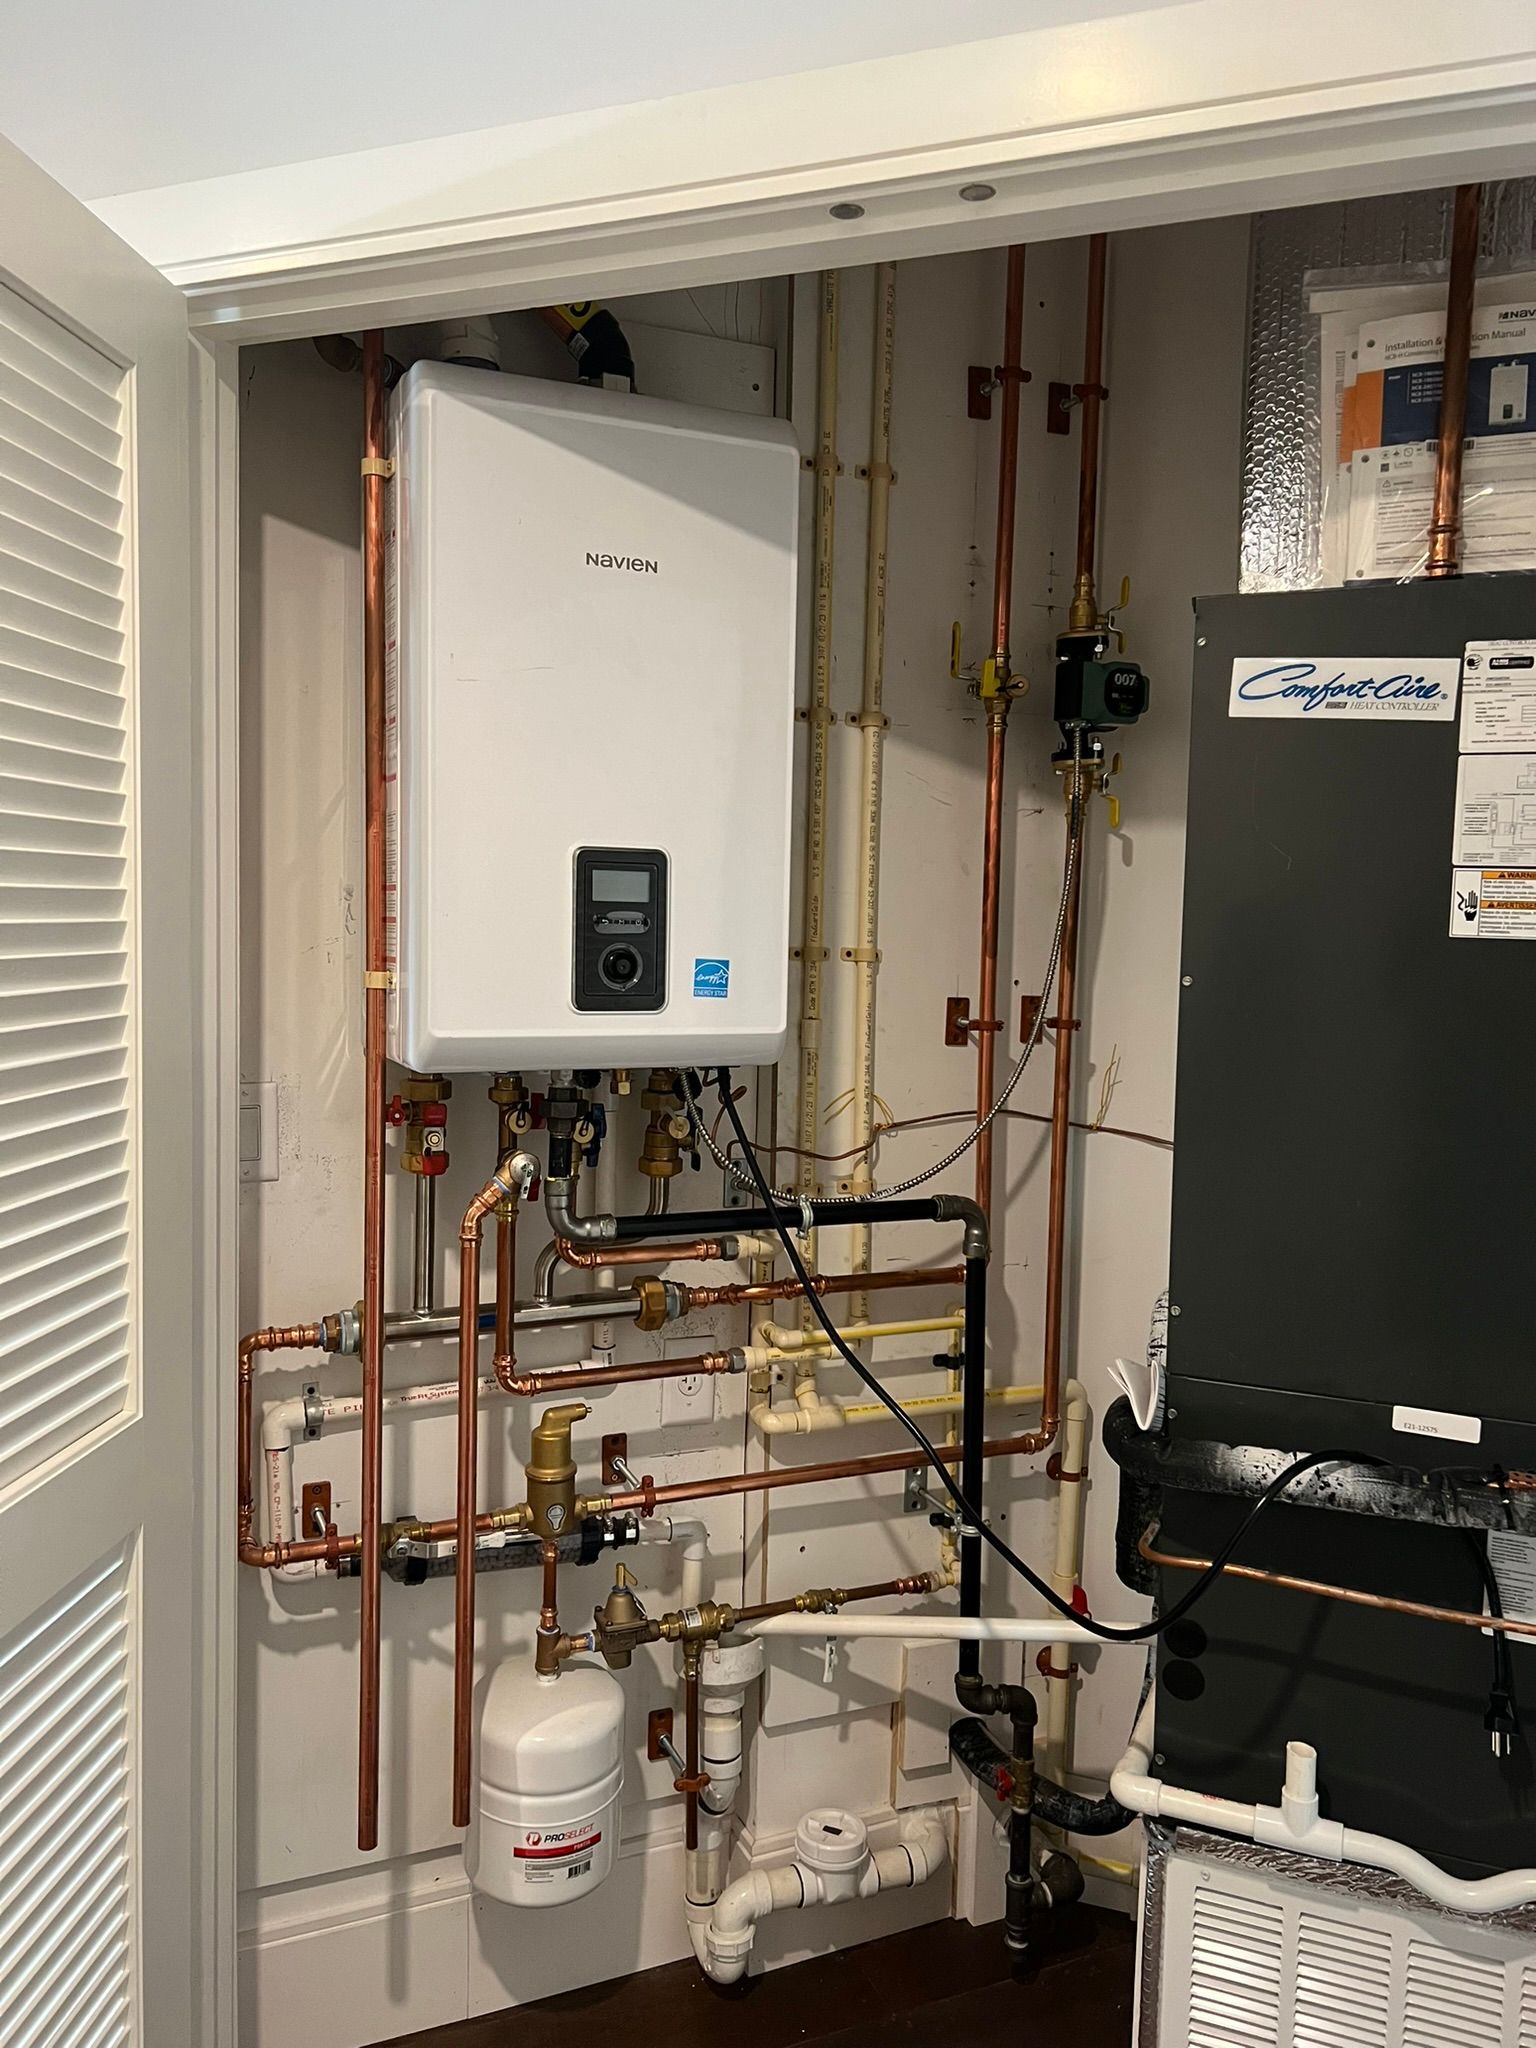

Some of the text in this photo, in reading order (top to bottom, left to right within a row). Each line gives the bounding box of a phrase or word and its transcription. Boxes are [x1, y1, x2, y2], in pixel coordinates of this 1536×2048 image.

[1385, 336, 1434, 352] Installation
[1491, 328, 1526, 339] Manual
[1114, 673, 1137, 686] 007
[1238, 663, 1442, 712] Comfort-Aire
[1349, 702, 1376, 710] HEAT
[1376, 702, 1439, 711] CONTROLLER
